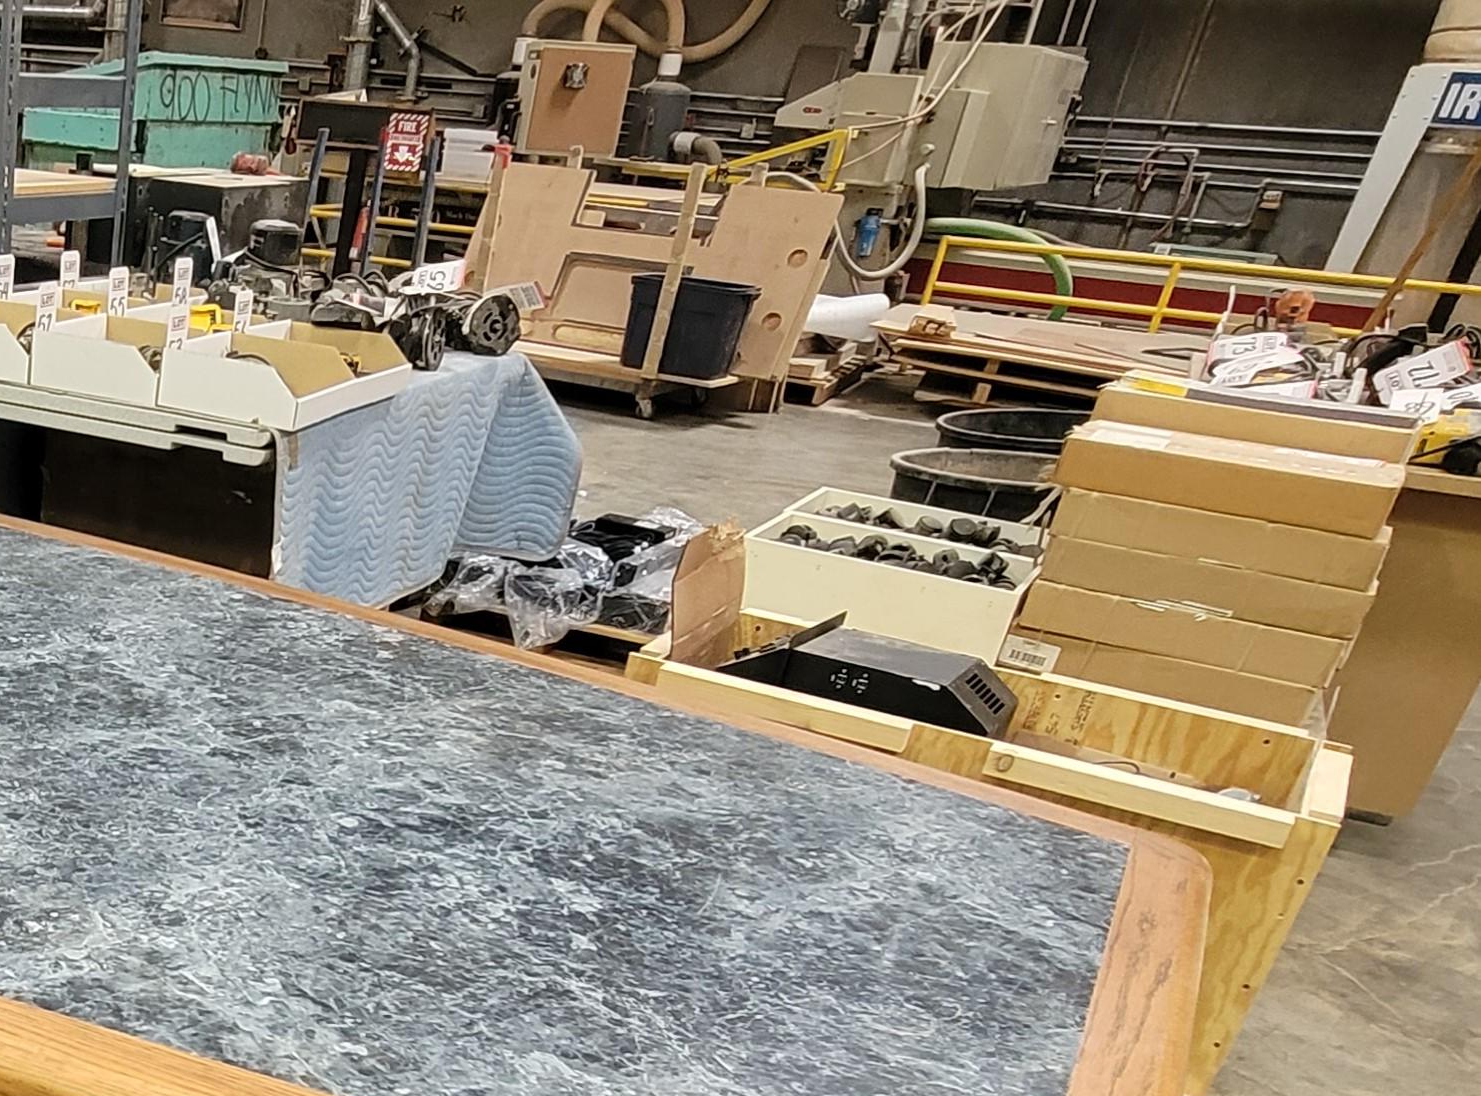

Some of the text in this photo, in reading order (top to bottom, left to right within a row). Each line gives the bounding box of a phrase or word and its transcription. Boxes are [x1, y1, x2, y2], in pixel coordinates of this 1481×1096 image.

[159, 69, 280, 121] 900 FLYNN
[397, 120, 419, 132] FIRE
[427, 270, 447, 290] 65
